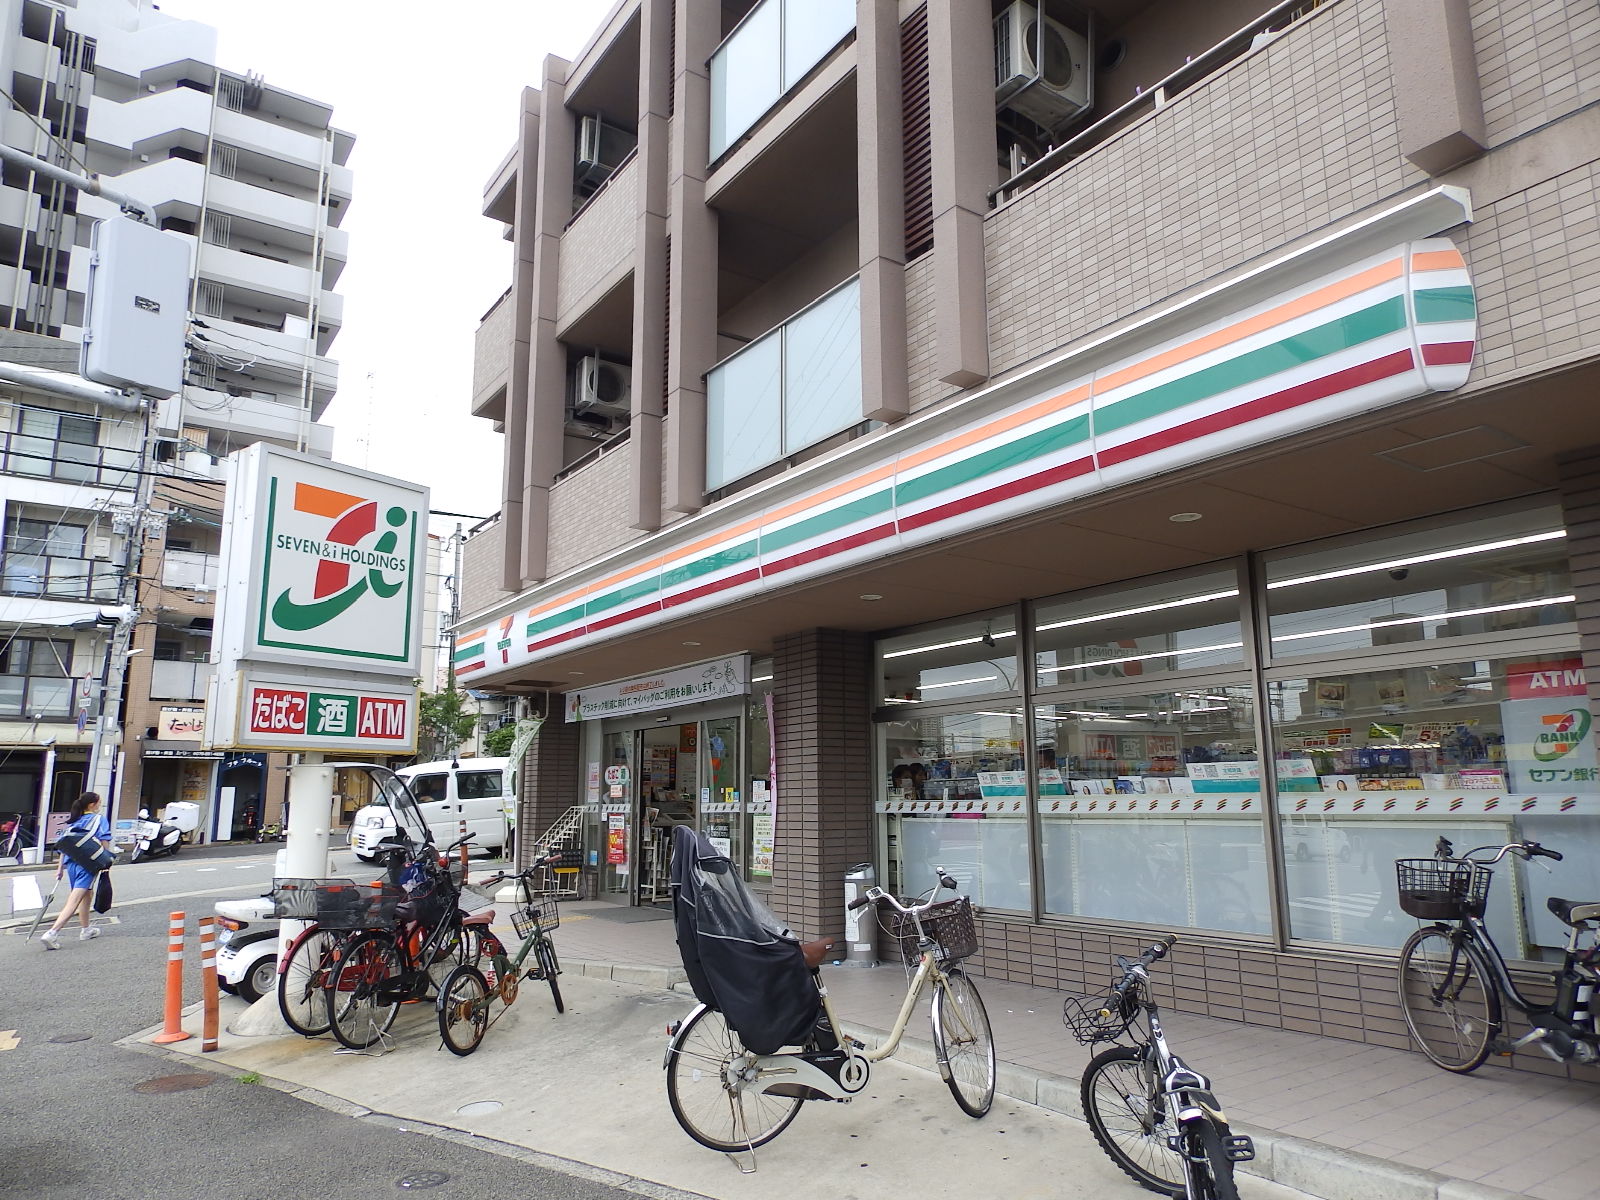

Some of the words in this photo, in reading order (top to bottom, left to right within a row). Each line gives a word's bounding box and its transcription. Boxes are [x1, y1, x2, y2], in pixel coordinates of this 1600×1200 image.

[277, 534, 337, 559] SEVEN&i
[340, 547, 406, 571] HOLDINGS
[1529, 669, 1587, 690] ATM
[253, 692, 305, 729] たばこ
[316, 698, 348, 733] 酒
[360, 701, 403, 736] ATM
[1540, 731, 1580, 743] BANK
